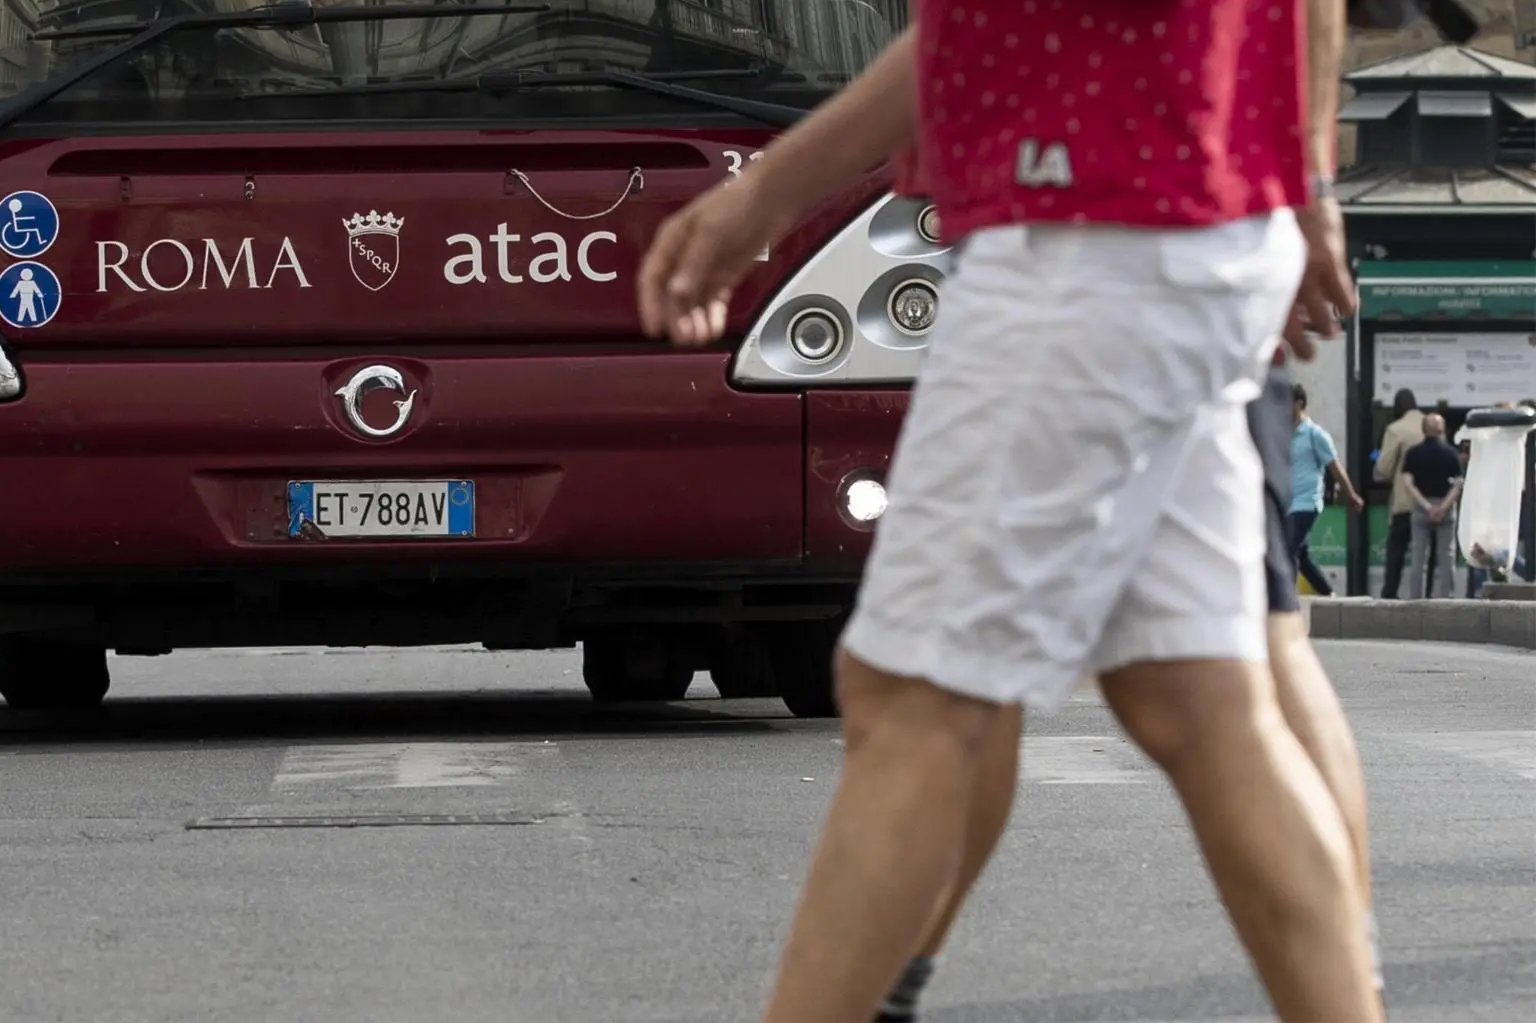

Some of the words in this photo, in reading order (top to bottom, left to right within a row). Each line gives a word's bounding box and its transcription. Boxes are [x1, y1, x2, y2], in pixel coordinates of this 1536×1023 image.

[95, 236, 312, 292] ROMA
[358, 244, 392, 274] SPQR
[444, 222, 617, 285] atac
